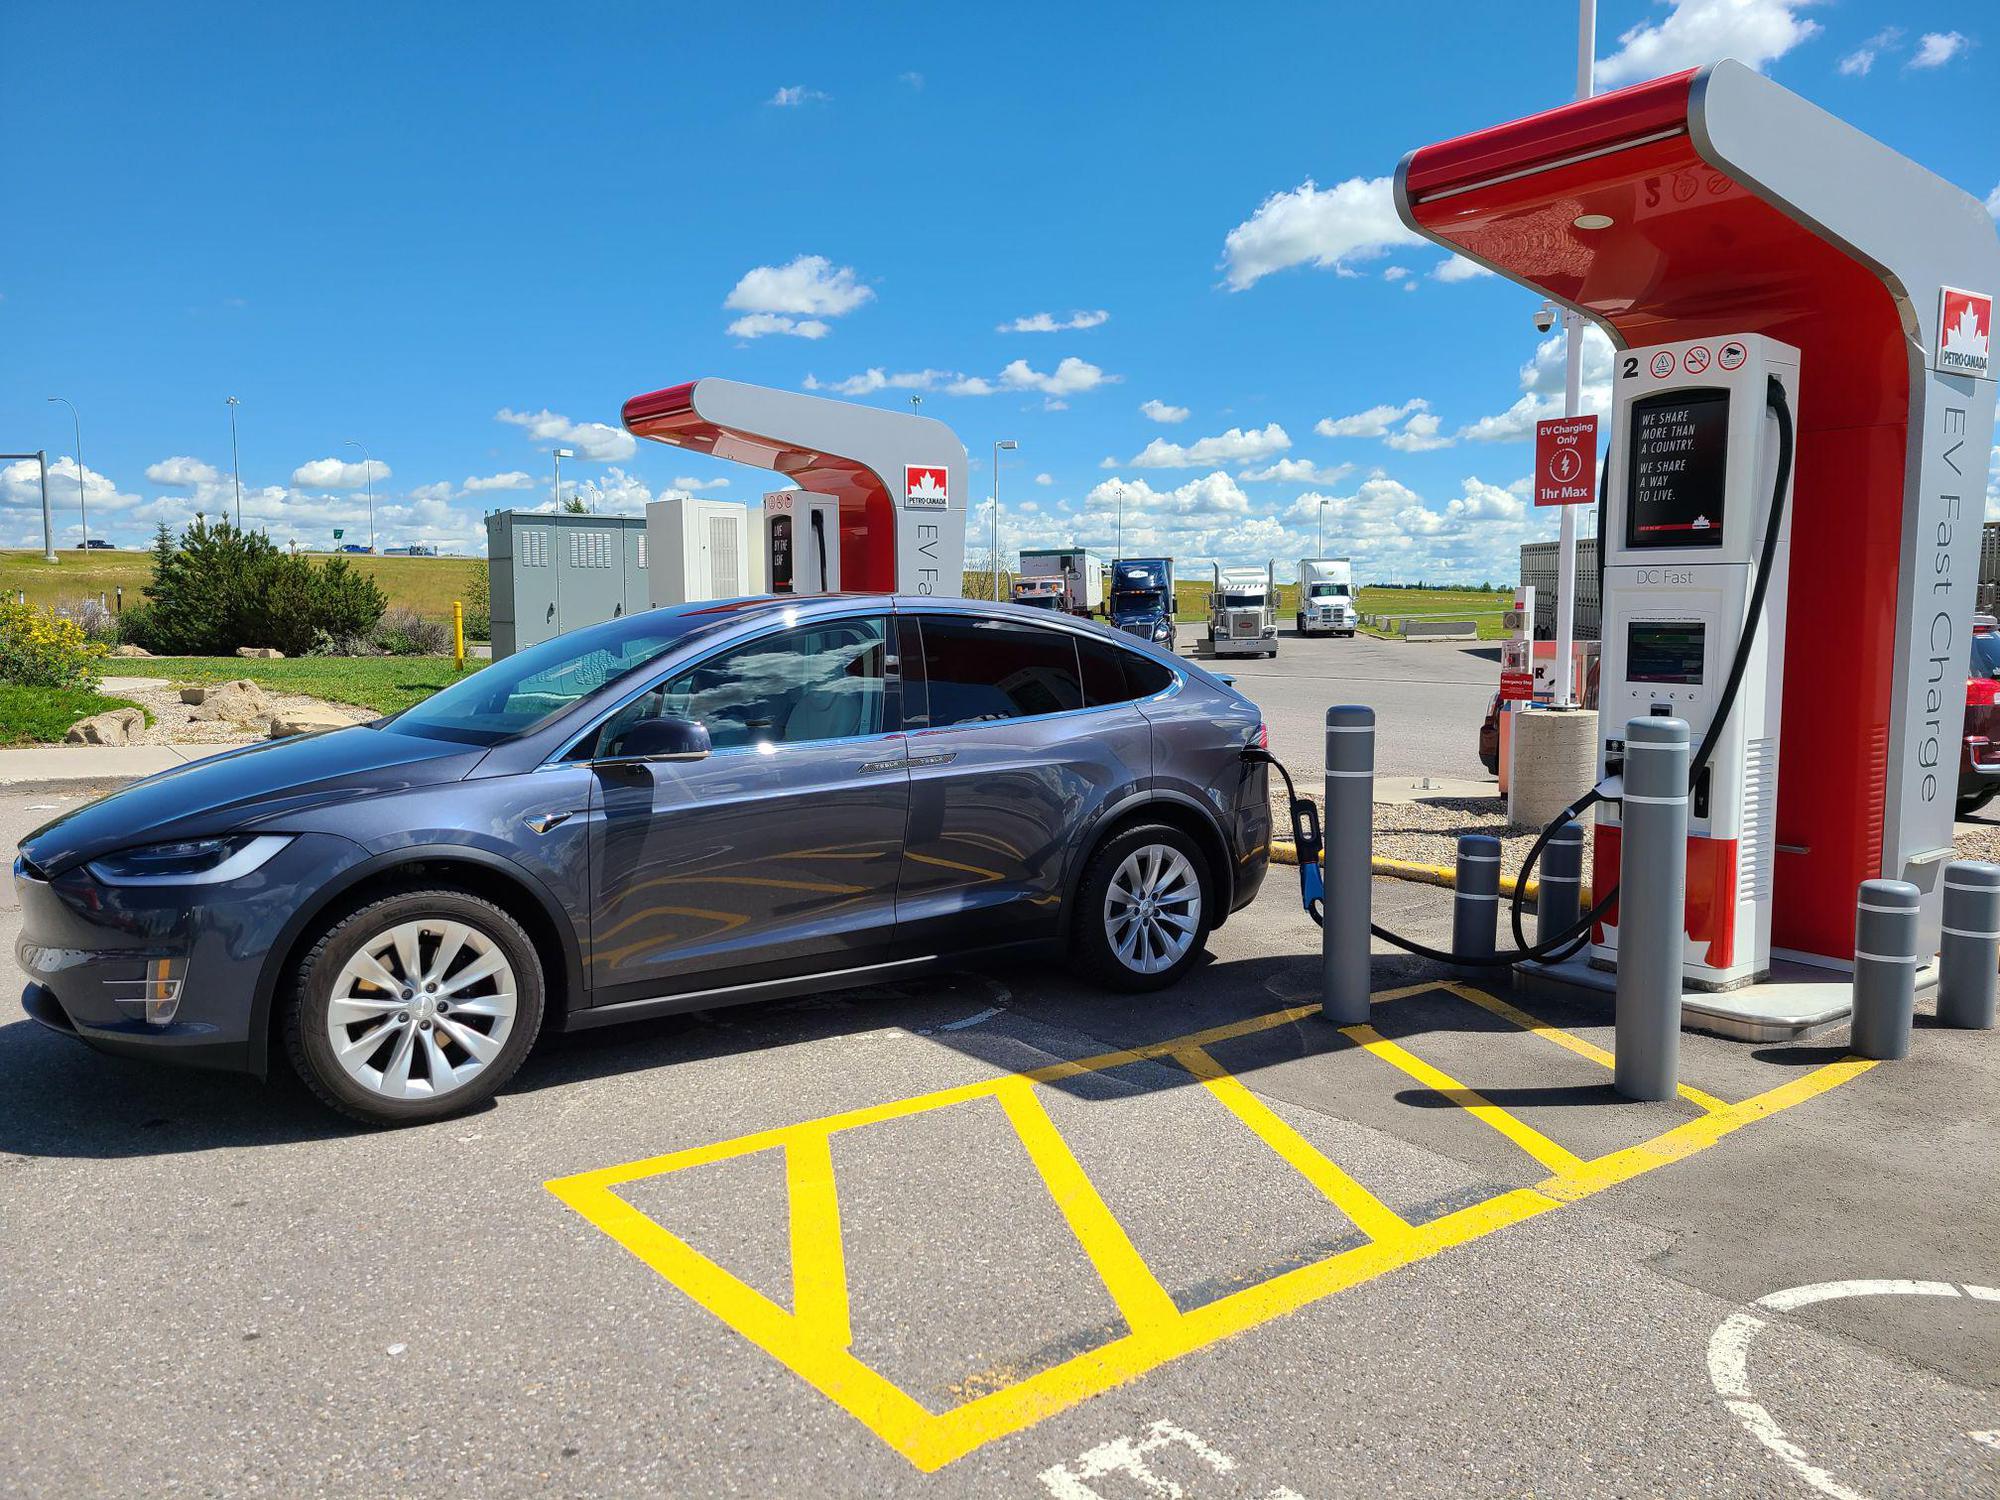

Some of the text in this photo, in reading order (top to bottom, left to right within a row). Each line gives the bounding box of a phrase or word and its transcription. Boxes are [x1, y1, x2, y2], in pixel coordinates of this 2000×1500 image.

[1622, 357, 1639, 379] 2
[1642, 410, 1689, 426] WE SHARE
[1540, 423, 1593, 436] EV Charging
[1642, 424, 1695, 440] MORE THAN
[1557, 435, 1578, 445] Only
[1641, 439, 1695, 454] A COUNTRY.
[1640, 460, 1686, 473] WE SHARE
[1640, 475, 1668, 487] A WAY
[1541, 486, 1588, 499] 1hr Max
[1639, 489, 1676, 501] TO LIVE.
[918, 525, 938, 595] EV Fa
[1636, 569, 1693, 584] DC Fast
[1918, 407, 1966, 802] EV Fast Charge
